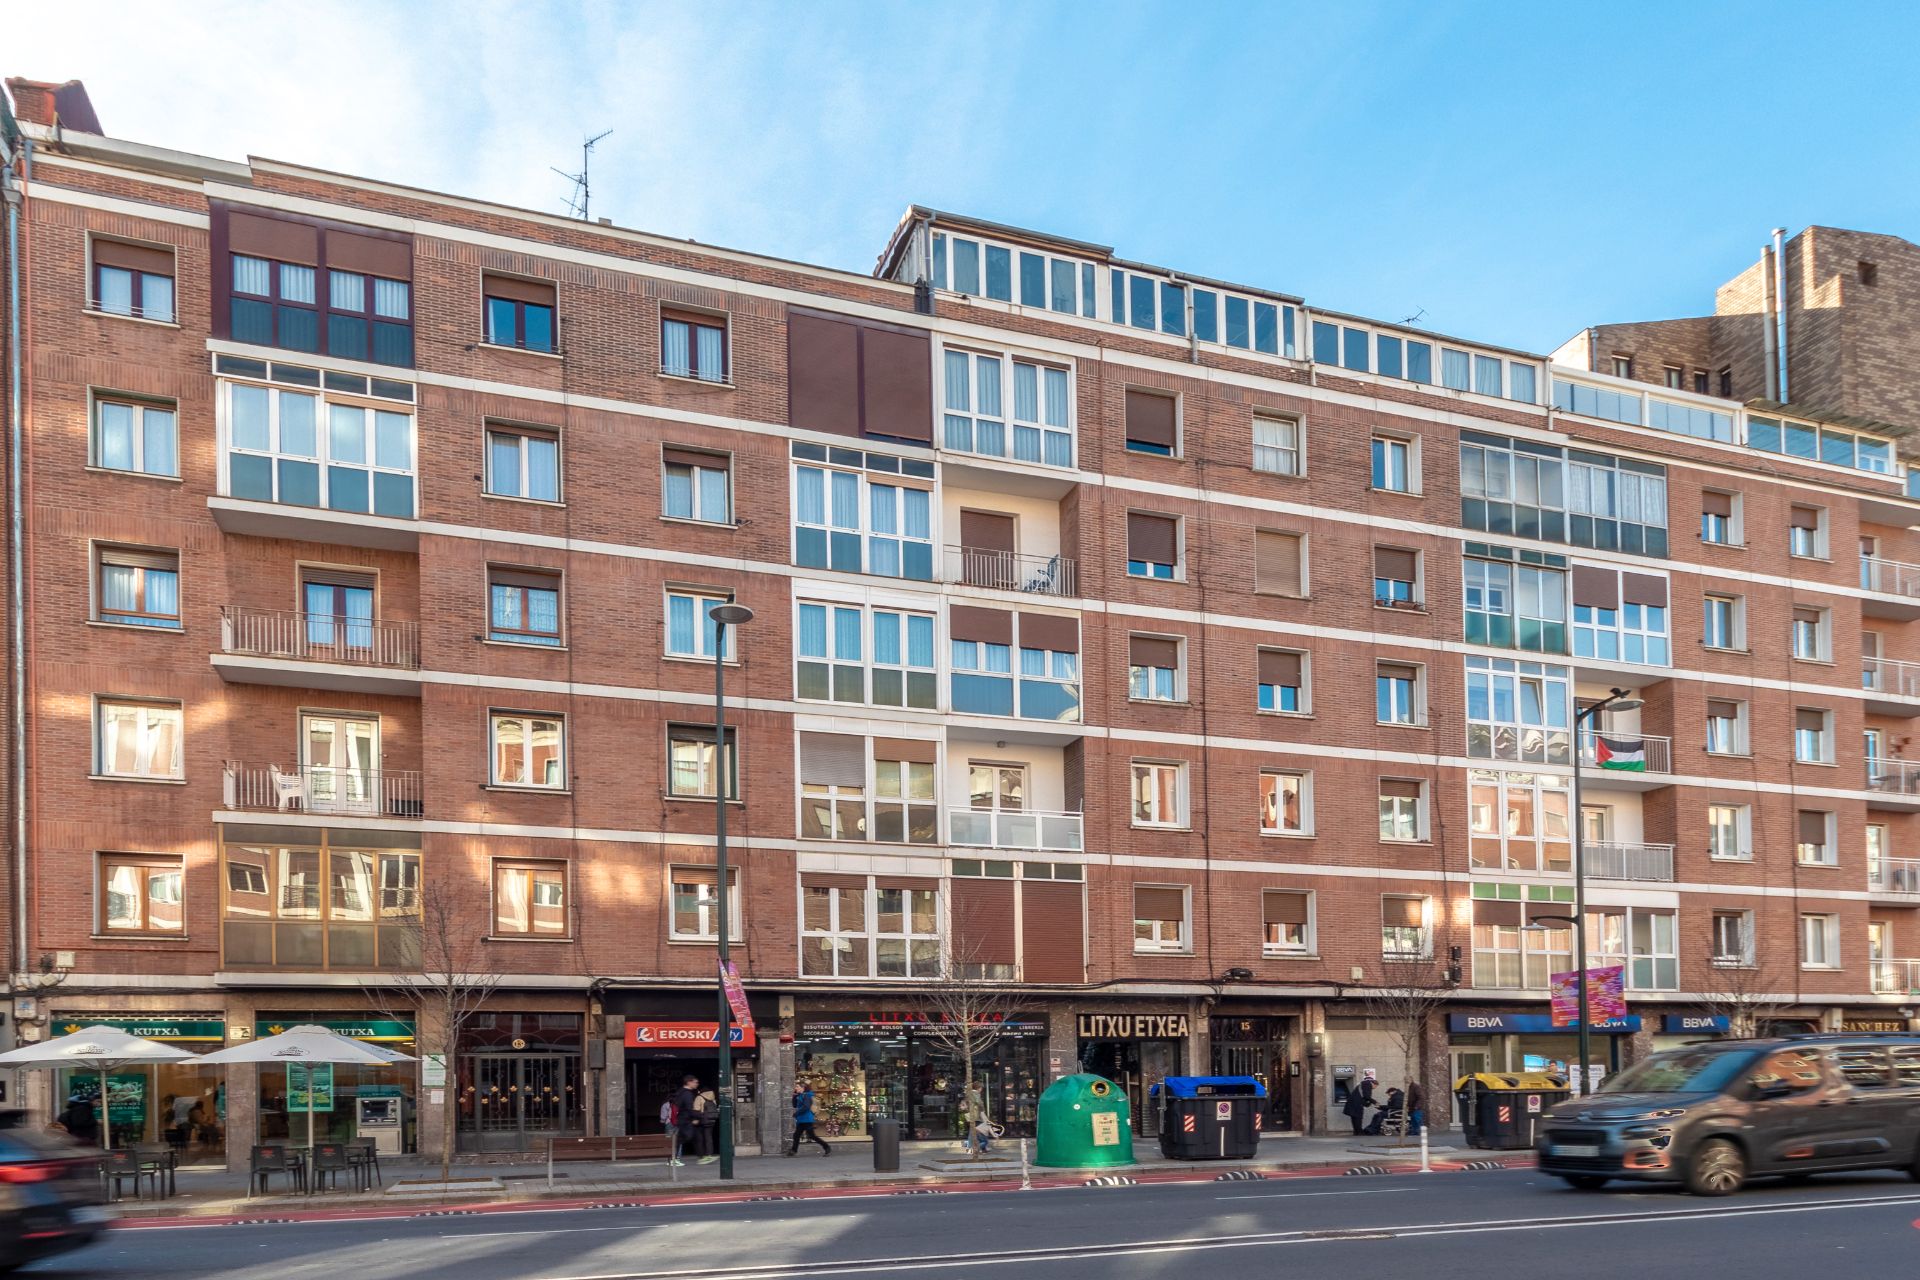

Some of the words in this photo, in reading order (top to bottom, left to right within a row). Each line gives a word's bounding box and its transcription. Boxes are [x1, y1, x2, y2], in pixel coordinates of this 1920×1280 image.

[1080, 1016, 1130, 1036] LITXU
[1135, 1016, 1188, 1036] ETXEA
[1241, 1022, 1250, 1030] 15
[1468, 1017, 1503, 1027] BBVA
[1683, 1017, 1714, 1028] BBVA
[1842, 1022, 1900, 1031] SANCHEZ
[660, 1030, 710, 1039] EROSKI
